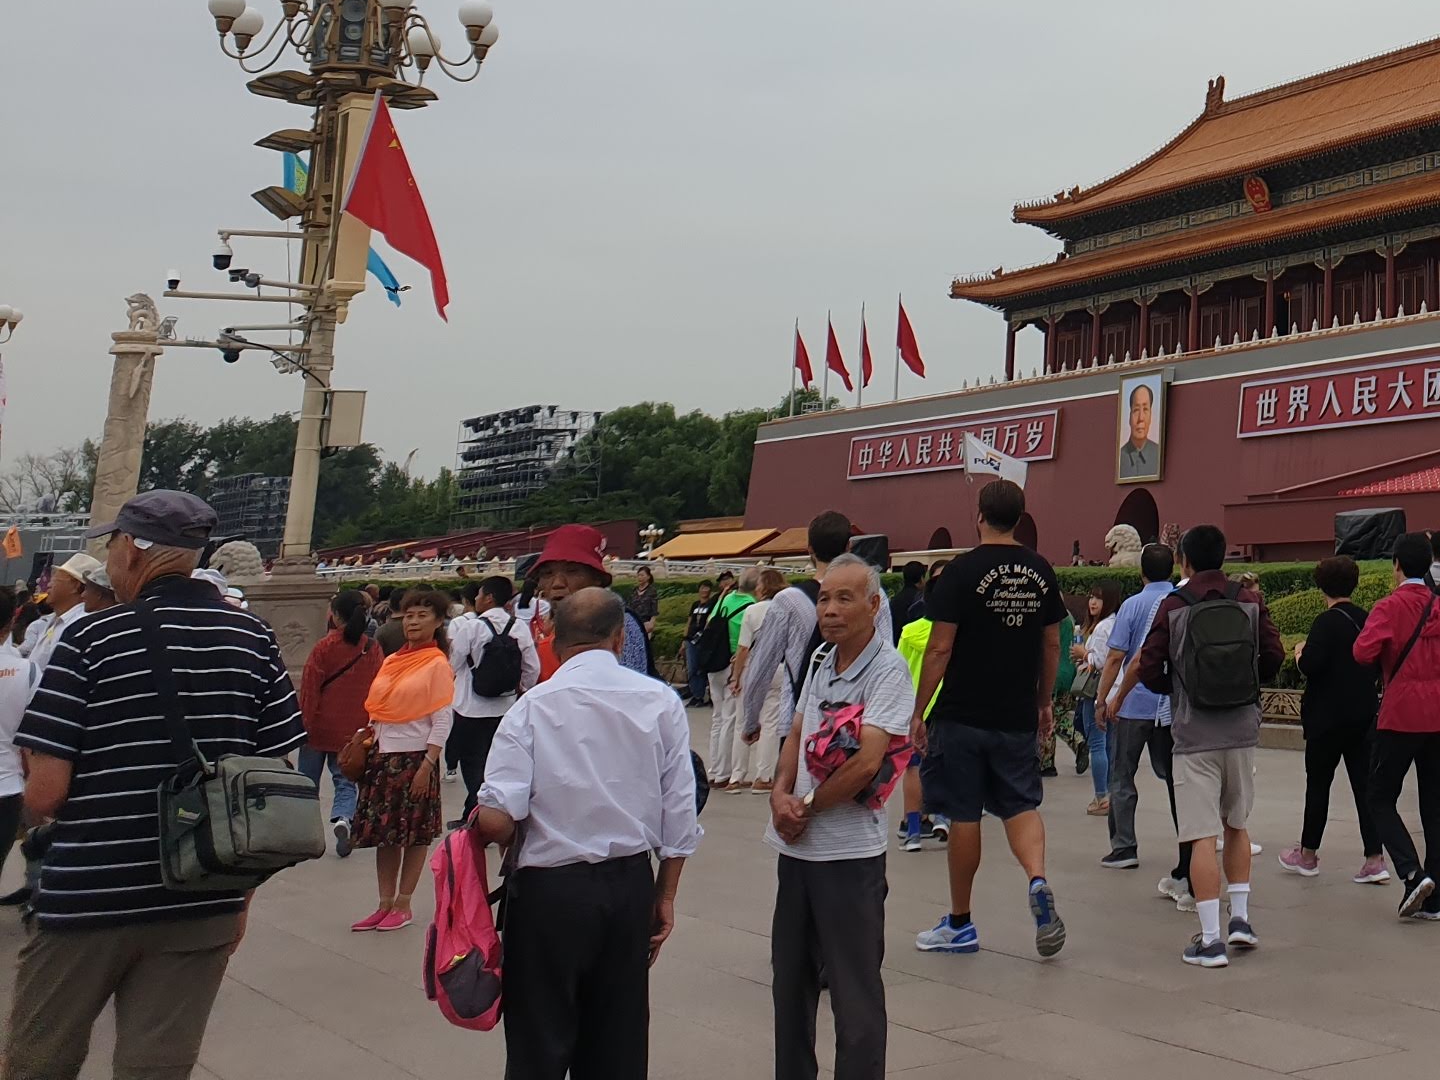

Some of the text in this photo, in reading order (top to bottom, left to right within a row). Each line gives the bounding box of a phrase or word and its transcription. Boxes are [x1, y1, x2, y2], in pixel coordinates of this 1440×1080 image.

[976, 564, 1049, 595] DEUS EX MACHINA
